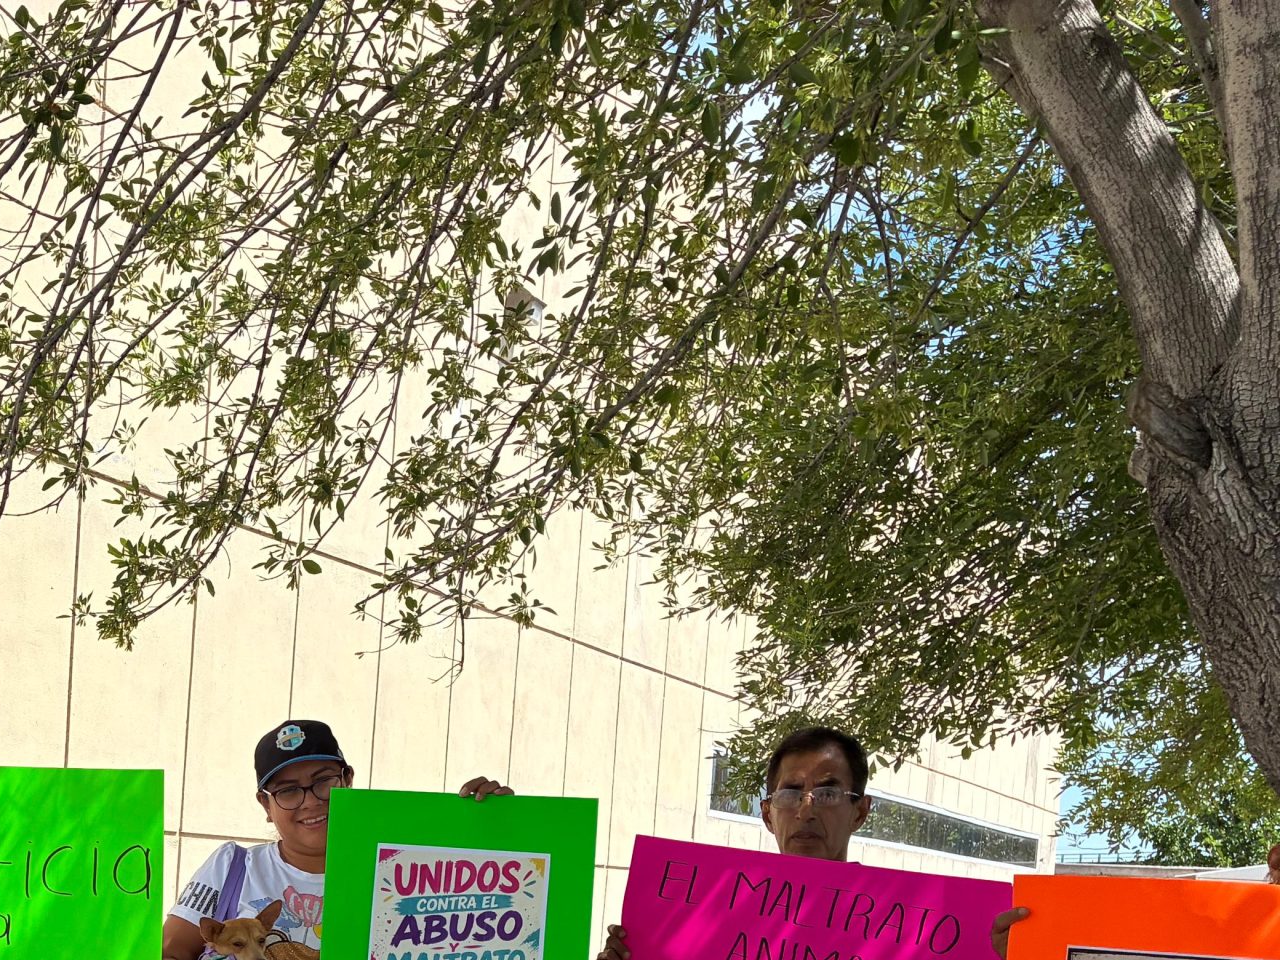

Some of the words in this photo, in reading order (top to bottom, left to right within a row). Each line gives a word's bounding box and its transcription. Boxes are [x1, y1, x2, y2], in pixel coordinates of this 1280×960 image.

[394, 860, 521, 896] UNIDOS
[416, 896, 477, 912] CONTRA
[481, 894, 498, 908] EL
[657, 860, 700, 905] EL
[728, 871, 961, 955] MALTRATO
[390, 910, 523, 948] ABUSO
[449, 943, 460, 953] Y
